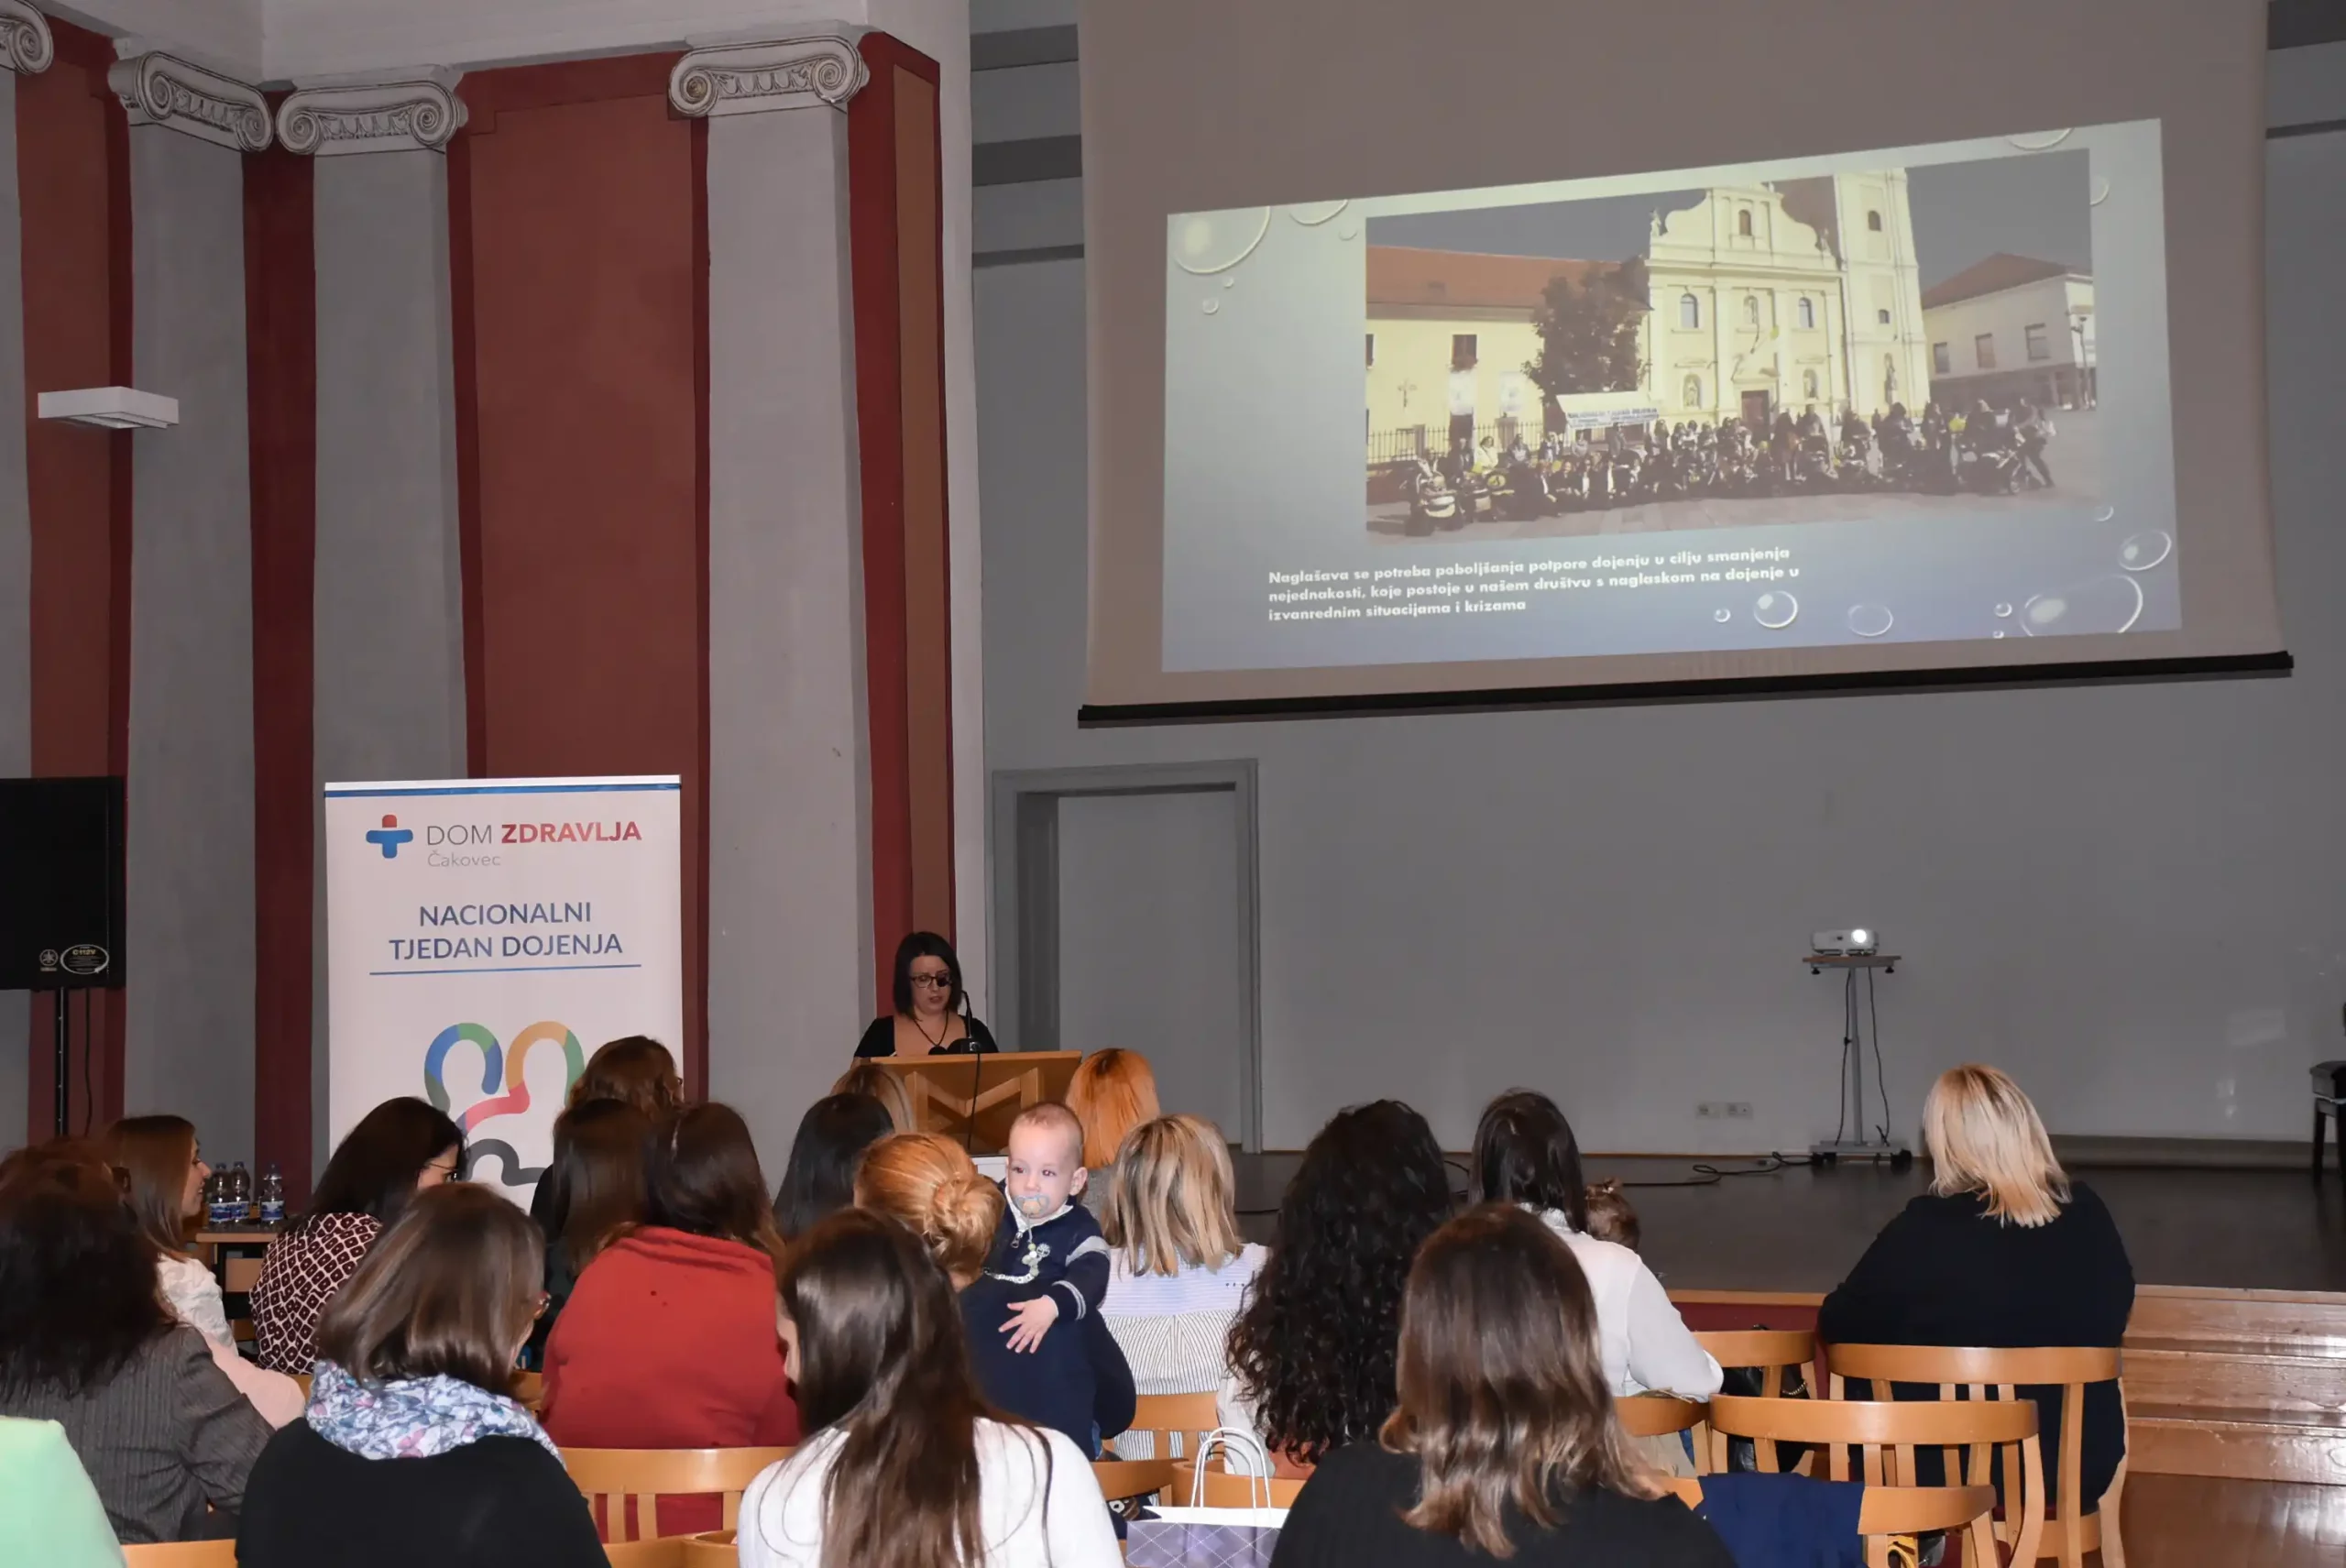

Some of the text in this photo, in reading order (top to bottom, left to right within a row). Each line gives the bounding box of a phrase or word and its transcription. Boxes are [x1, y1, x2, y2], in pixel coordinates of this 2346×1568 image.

[1268, 546, 1791, 586] Naglašava se potreba poboljšanja potpore dojenju u cilju smanjenja
[1268, 566, 1800, 604] nejednakosti, koje postoje u našem društvu s naglaskom na dojenje u
[1268, 606, 1361, 621] izvanrednim
[1365, 601, 1451, 618] situacijama
[1464, 599, 1527, 613] krizama
[426, 821, 642, 847] DOM ZDRAVLJA
[427, 850, 501, 868] Čakovec
[419, 902, 591, 927] NACIONALNI
[389, 933, 623, 959] TJEDAN DOJENJA
